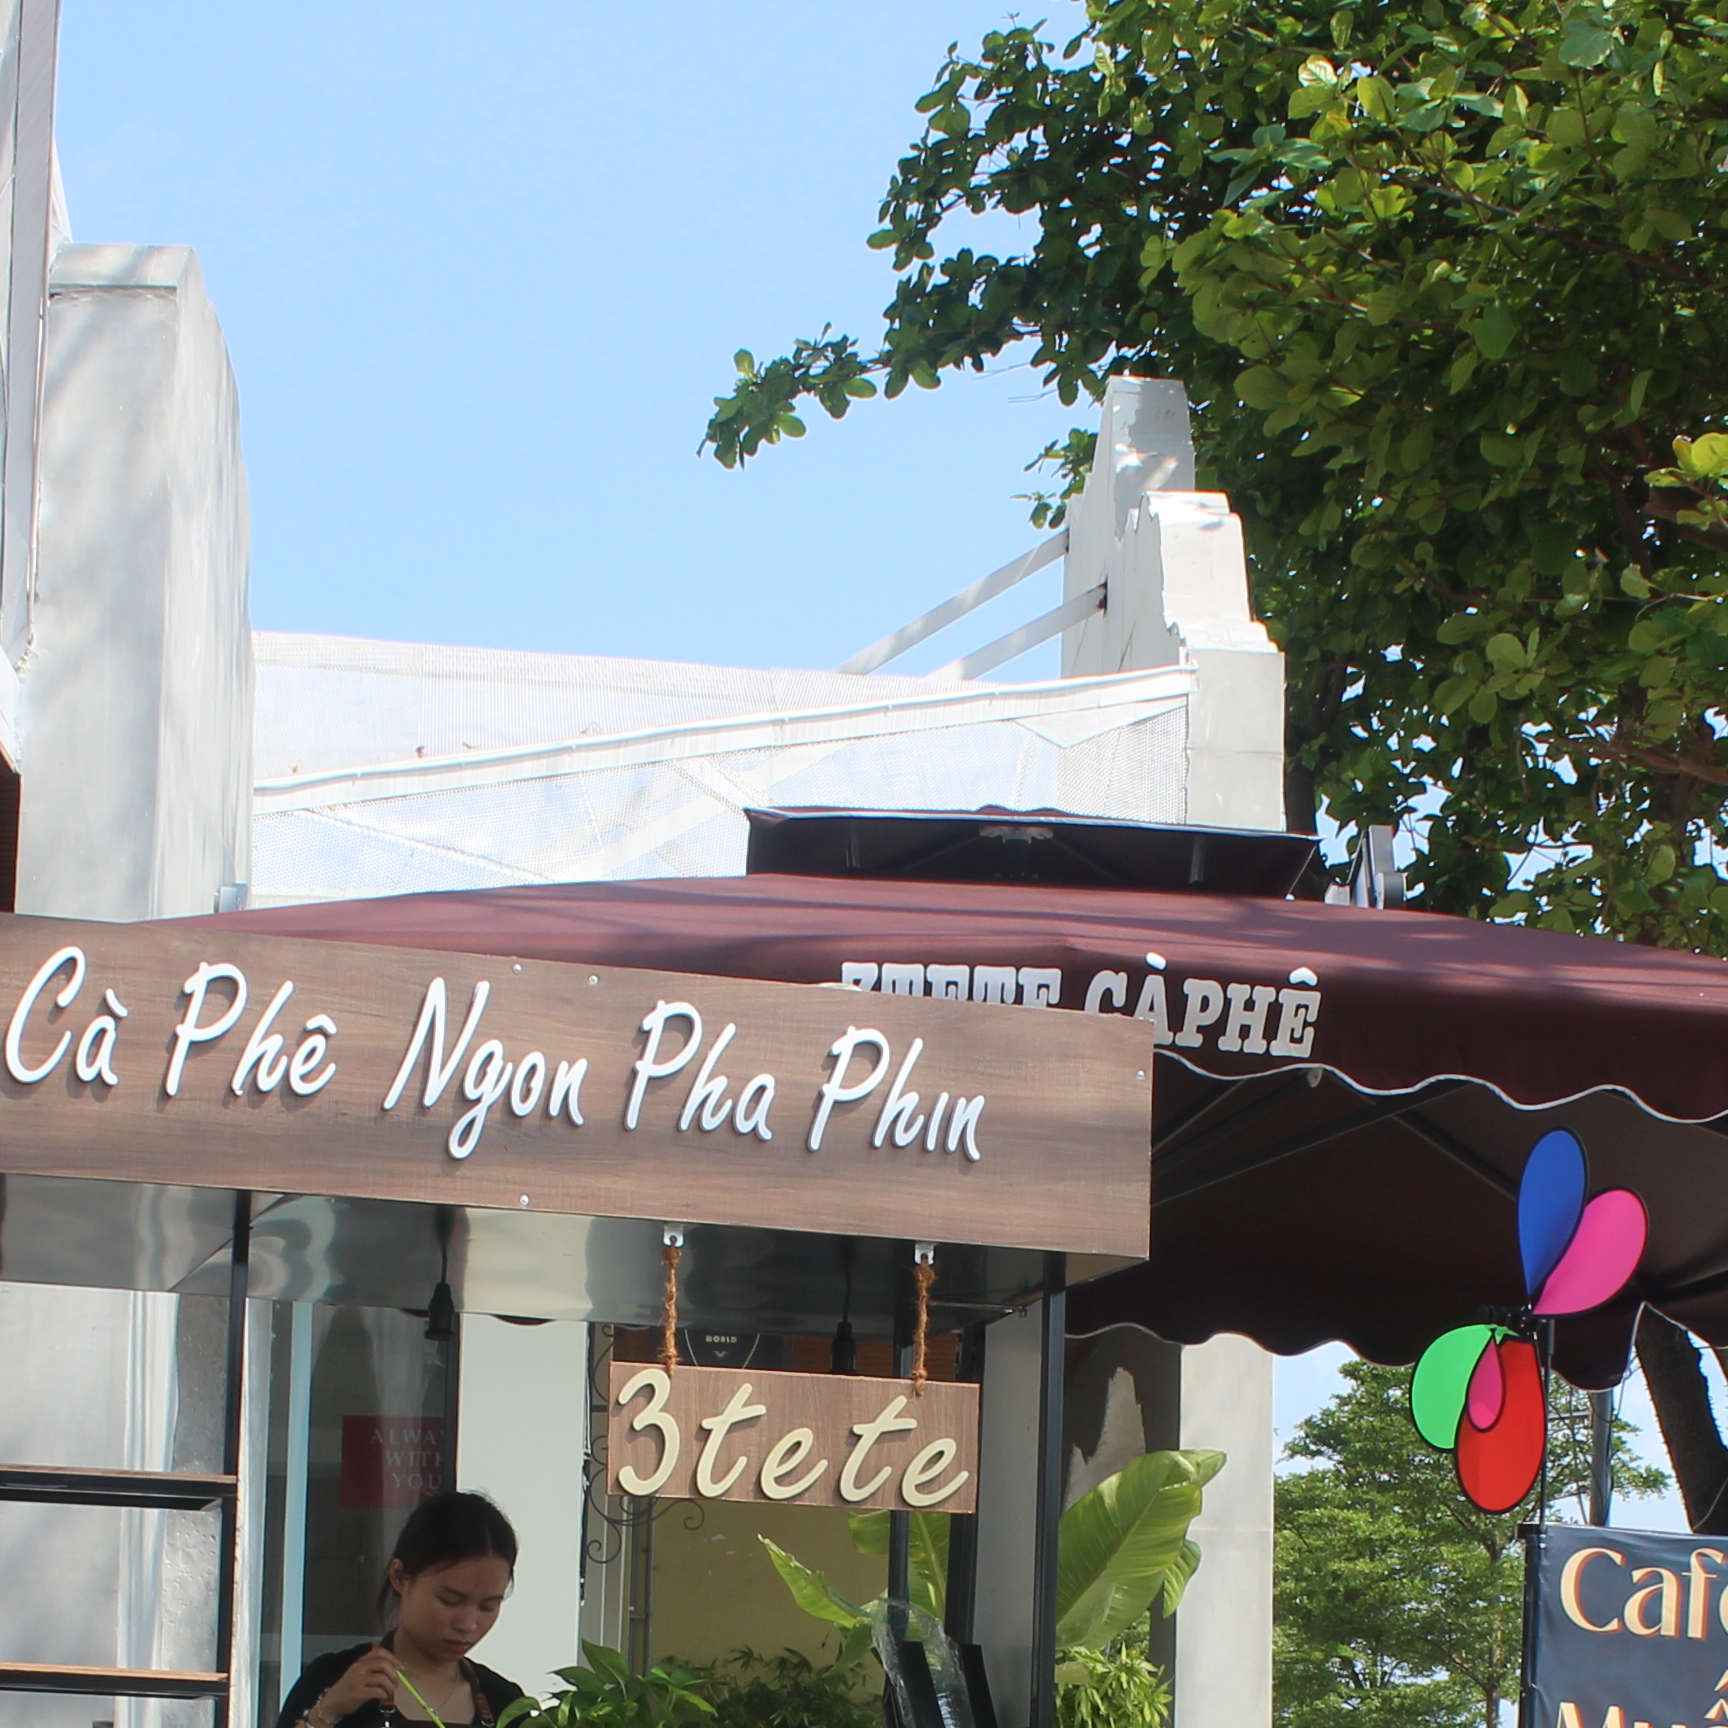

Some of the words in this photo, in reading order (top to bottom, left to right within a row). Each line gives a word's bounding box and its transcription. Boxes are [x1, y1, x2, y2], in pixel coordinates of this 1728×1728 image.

[4, 945, 129, 1087] Cà
[166, 961, 338, 1097] Phê
[382, 976, 588, 1161] Ngon
[625, 999, 775, 1141] Pha
[705, 1335, 738, 1344] WORLD
[370, 1428, 445, 1446] ALWA
[618, 1368, 970, 1507] 3tete
[392, 1473, 442, 1490] YOU
